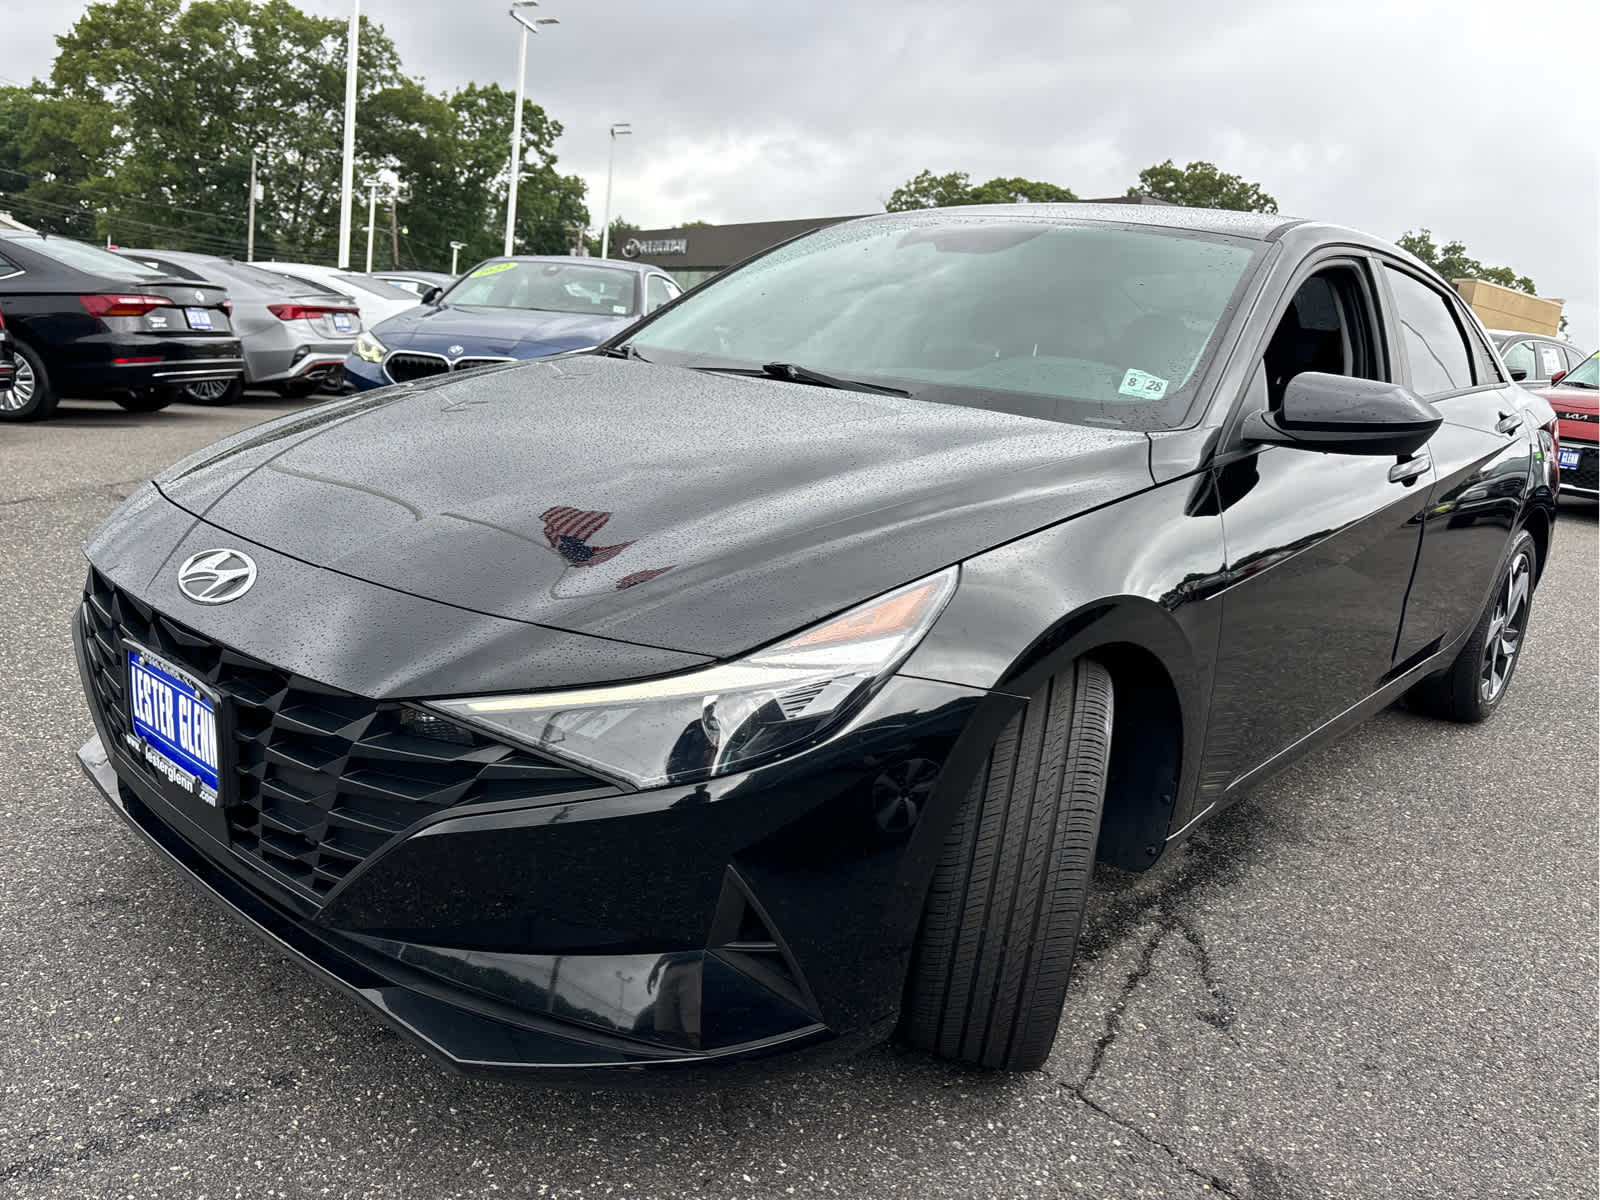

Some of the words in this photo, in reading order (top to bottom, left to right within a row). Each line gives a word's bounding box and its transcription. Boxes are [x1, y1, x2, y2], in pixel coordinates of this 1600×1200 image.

[1127, 378, 1137, 387] 8
[1145, 380, 1163, 392] 28
[131, 665, 176, 742] LESTER
[178, 693, 218, 771] GLENN
[145, 745, 194, 793] lesterglenn
